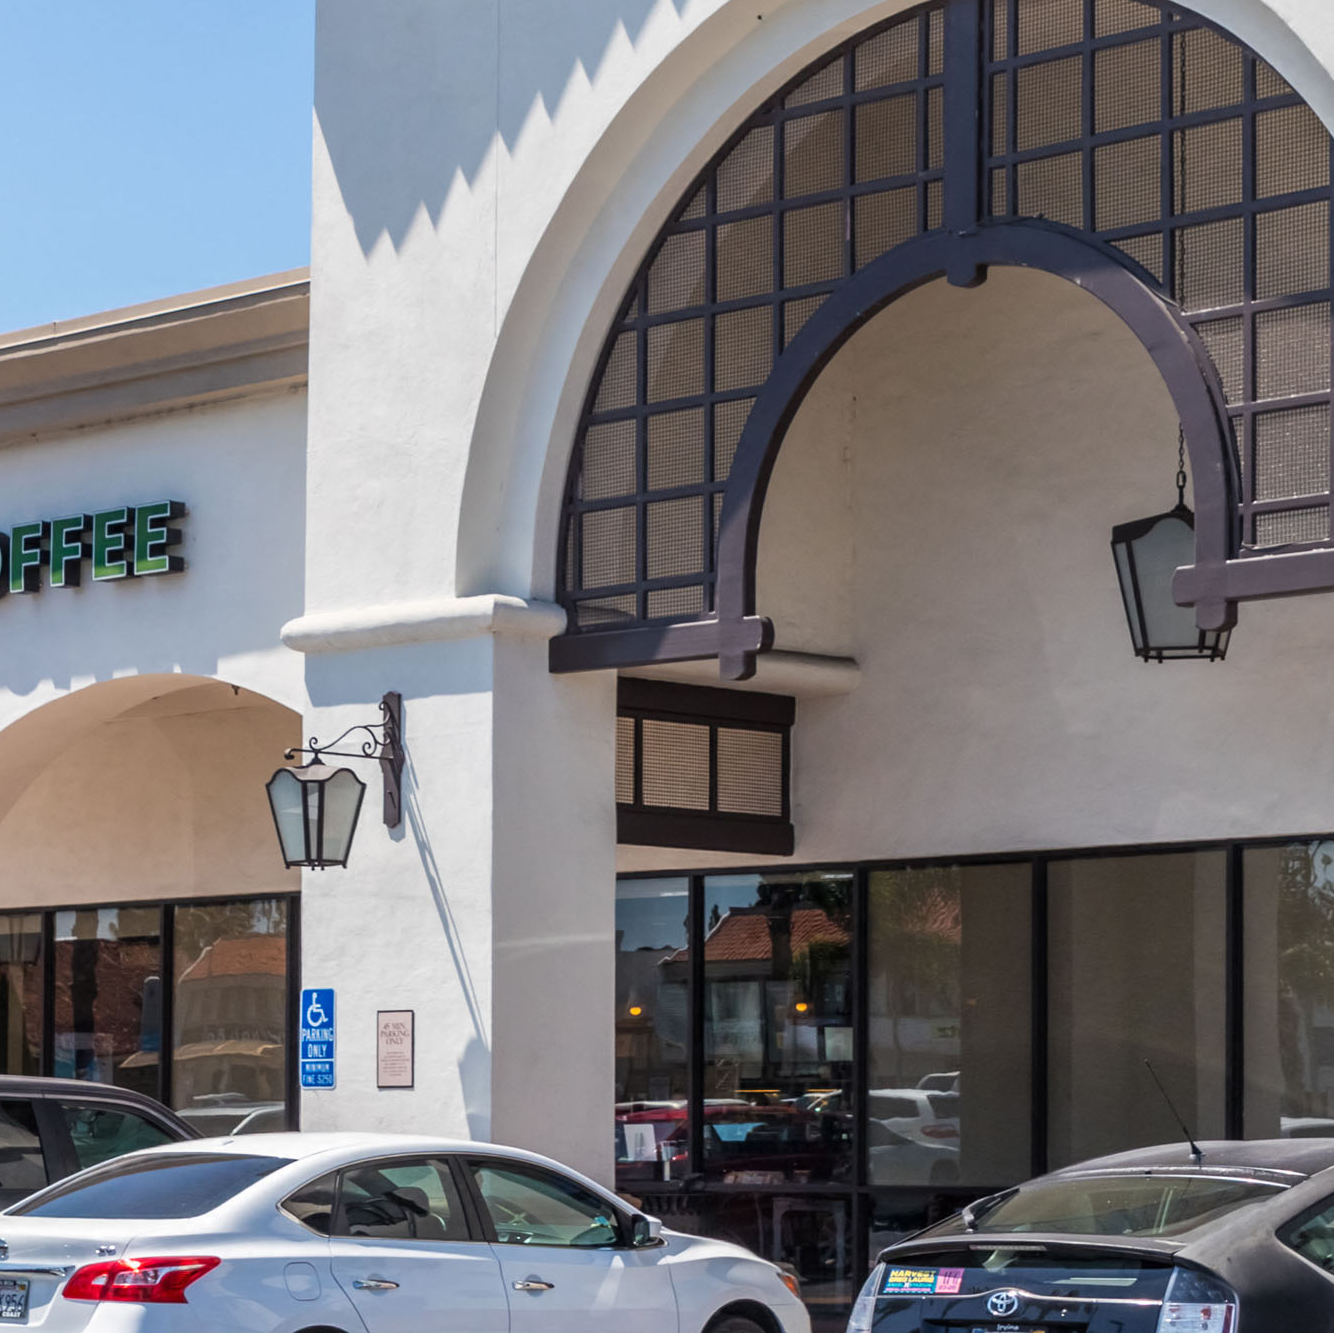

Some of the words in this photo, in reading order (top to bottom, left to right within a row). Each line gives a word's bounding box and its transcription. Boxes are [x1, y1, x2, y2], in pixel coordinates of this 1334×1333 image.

[301, 1027, 334, 1042] PARKING
[307, 1043, 328, 1058] ONLY
[302, 1074, 317, 1084] FINE
